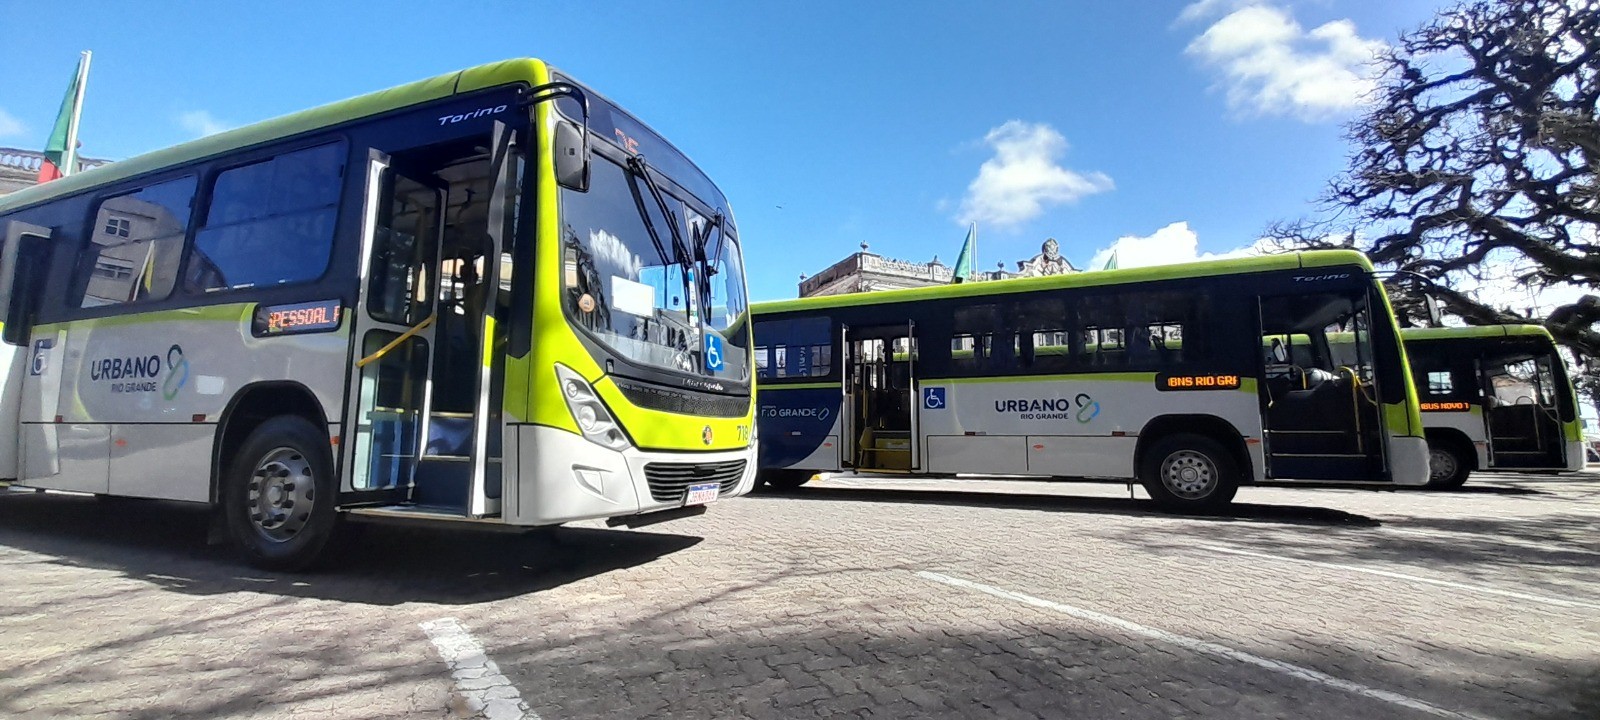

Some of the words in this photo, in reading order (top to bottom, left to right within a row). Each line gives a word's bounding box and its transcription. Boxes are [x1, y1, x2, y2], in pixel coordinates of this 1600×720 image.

[438, 105, 508, 126] Torino
[1292, 273, 1350, 282] Torino
[91, 355, 160, 381] URBANO
[1195, 376, 1214, 386] RIO
[111, 384, 124, 393] RIO
[125, 382, 156, 393] GRANDE
[995, 399, 1069, 413] URBANO
[779, 408, 817, 417] GRANDE
[736, 424, 749, 442] 718
